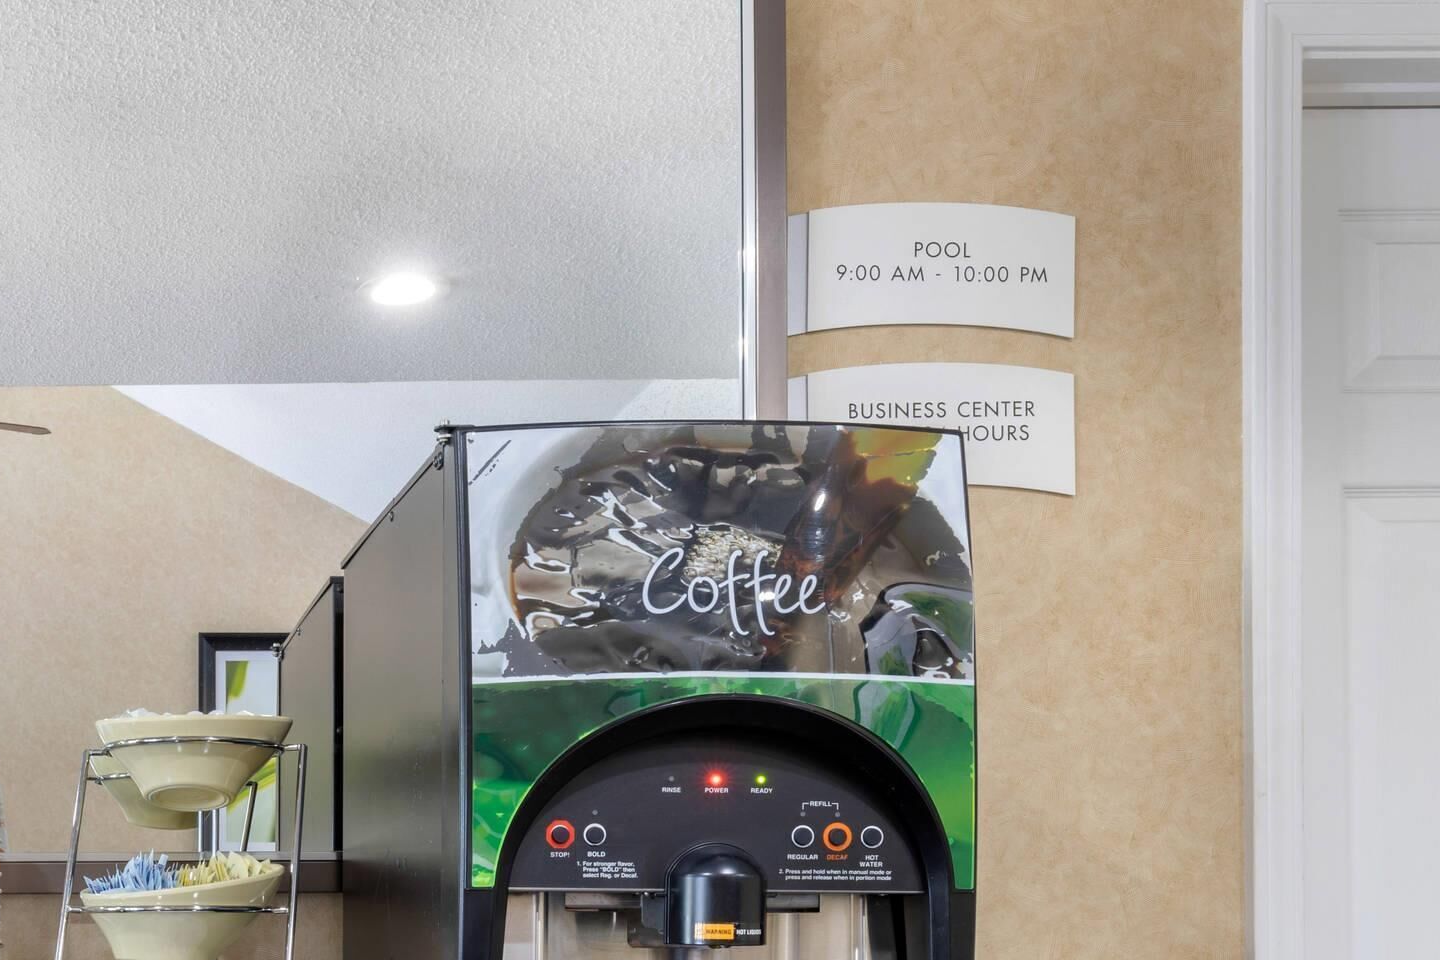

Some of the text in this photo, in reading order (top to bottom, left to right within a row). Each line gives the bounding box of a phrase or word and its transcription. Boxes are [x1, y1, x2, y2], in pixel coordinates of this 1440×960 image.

[913, 241, 971, 259] POOL
[836, 264, 881, 281] 9:00
[890, 266, 925, 282] AM
[954, 266, 1009, 283] 10:00
[1020, 267, 1048, 283] PM
[848, 401, 1035, 419] BUSINESS CENTER
[642, 547, 826, 636] Coffee
